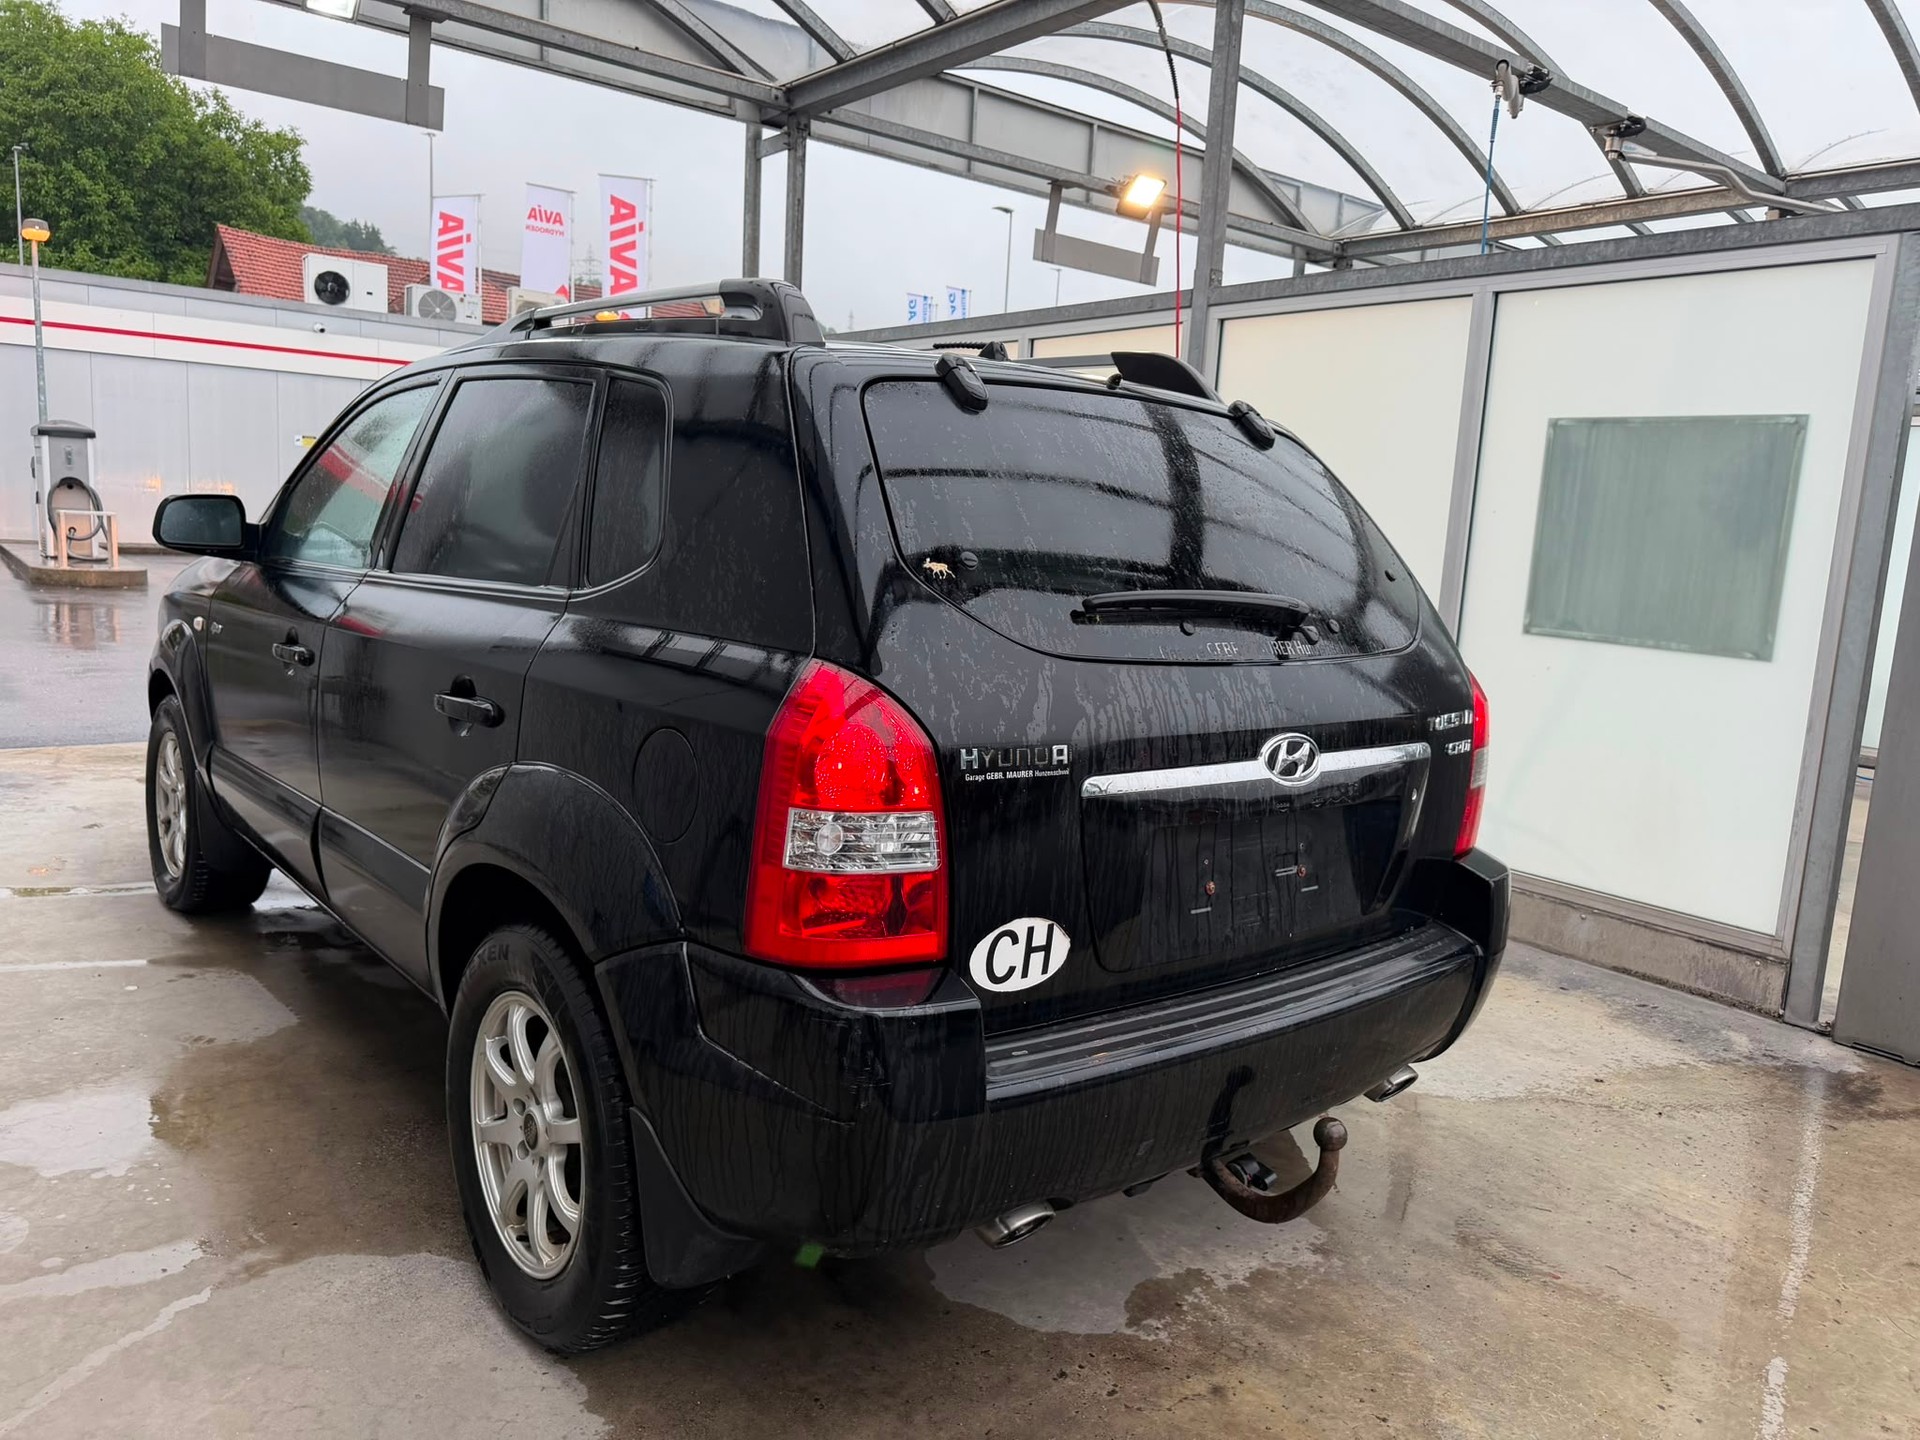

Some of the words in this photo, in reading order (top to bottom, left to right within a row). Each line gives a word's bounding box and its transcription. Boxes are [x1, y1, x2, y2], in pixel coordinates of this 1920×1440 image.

[965, 773, 985, 782] Garage
[1006, 770, 1034, 779] MAURER
[985, 922, 1055, 985] CH
